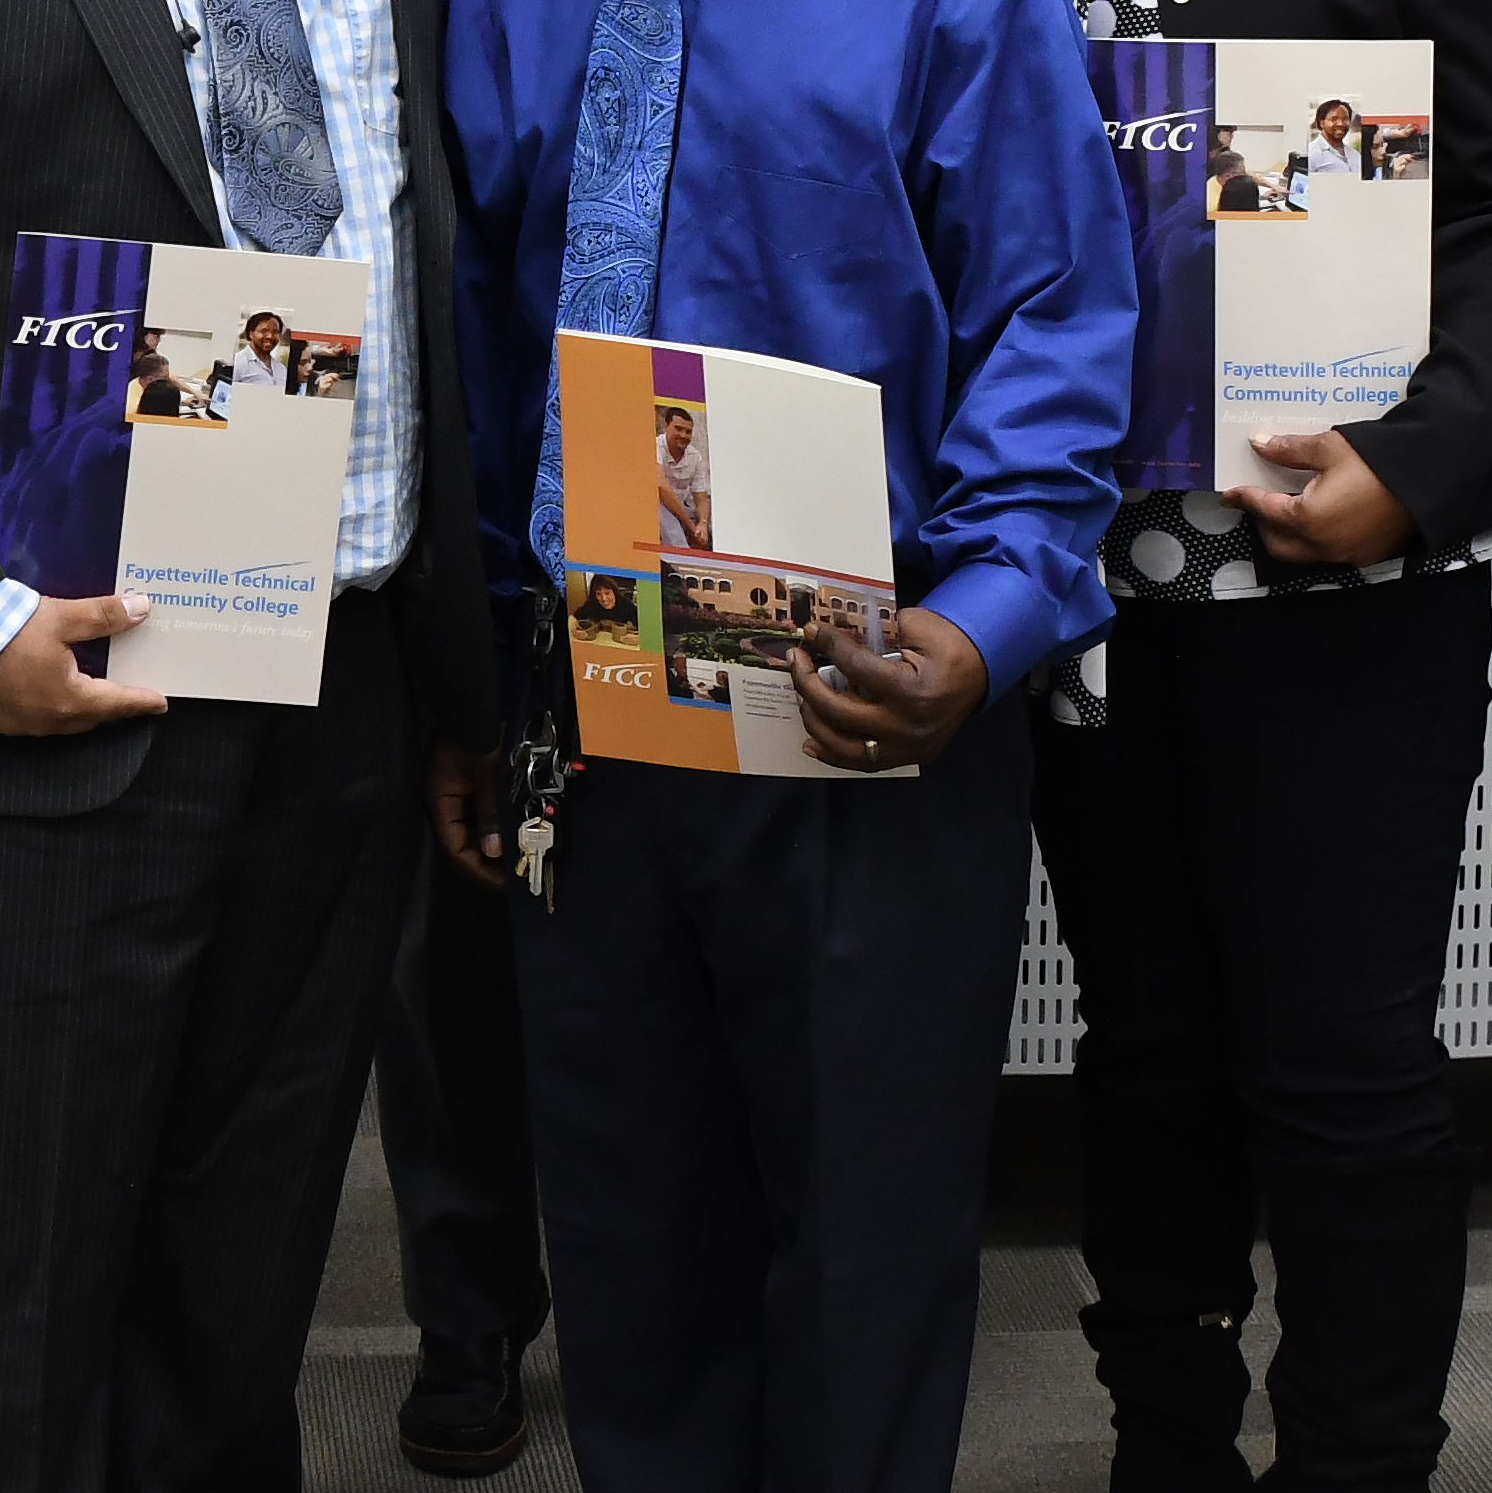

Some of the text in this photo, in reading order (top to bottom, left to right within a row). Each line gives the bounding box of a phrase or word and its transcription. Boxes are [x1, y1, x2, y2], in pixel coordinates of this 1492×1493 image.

[12, 310, 141, 352] FTCC
[1223, 351, 1413, 381] Fayetteville Technical
[1223, 385, 1399, 406] Community College
[125, 563, 316, 592] Fayetteville Technical
[124, 587, 299, 618] mmunity College
[583, 662, 657, 689] FTCC
